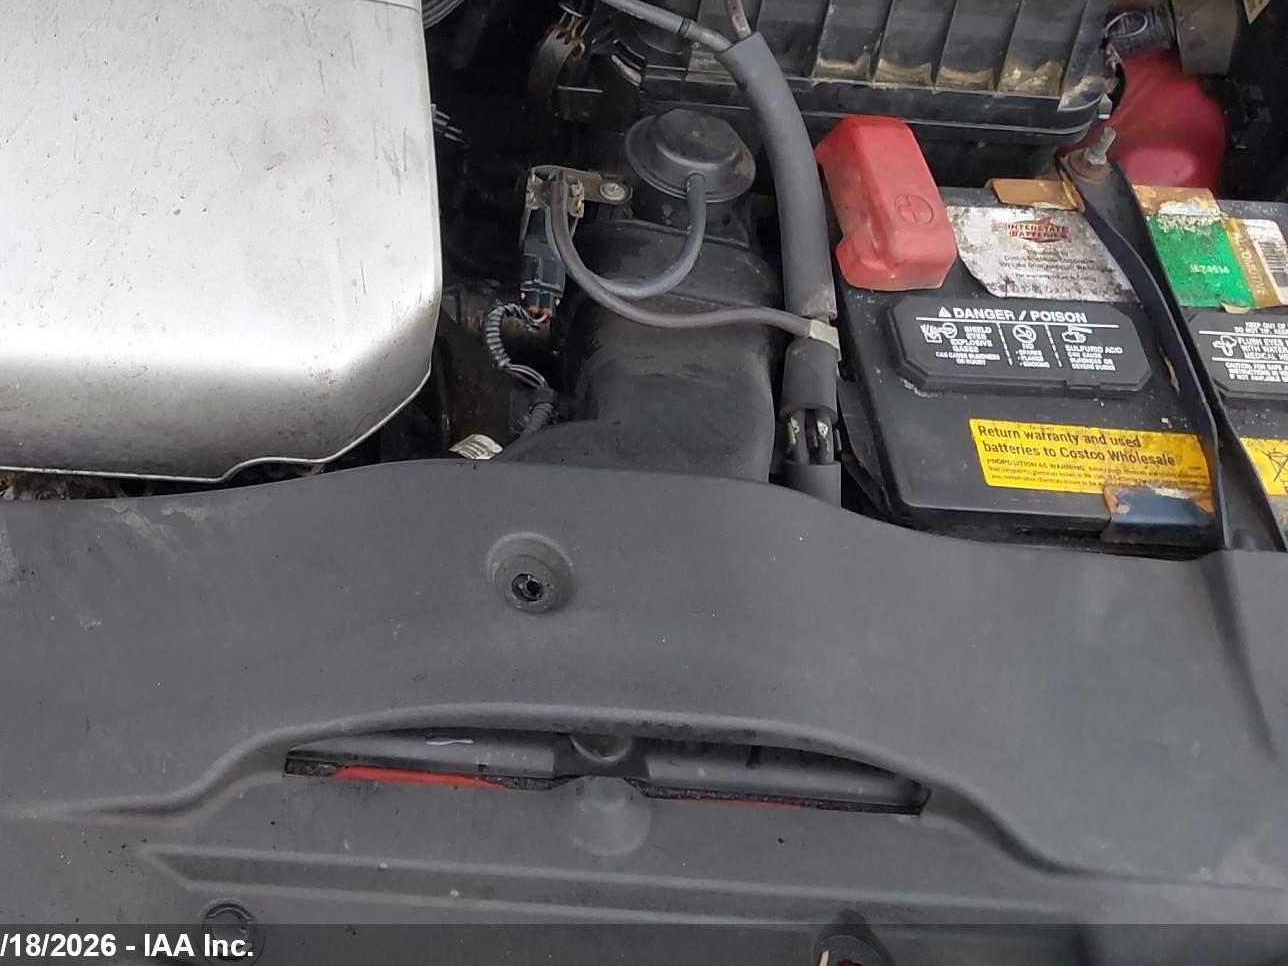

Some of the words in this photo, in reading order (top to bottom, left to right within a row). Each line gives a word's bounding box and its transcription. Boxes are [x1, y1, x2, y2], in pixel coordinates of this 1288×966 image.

[952, 307, 1016, 320] DANGER
[1018, 310, 1027, 320] /
[1030, 311, 1088, 323] POISON
[964, 325, 993, 334] SHIELD
[978, 425, 1021, 439] Return
[1024, 428, 1079, 446] warranty
[1084, 433, 1107, 445] and
[1110, 435, 1142, 448] used
[983, 441, 1041, 457] batteries
[1043, 446, 1056, 458] to
[1060, 447, 1106, 461] Costco
[1109, 449, 1176, 467] Wholesale
